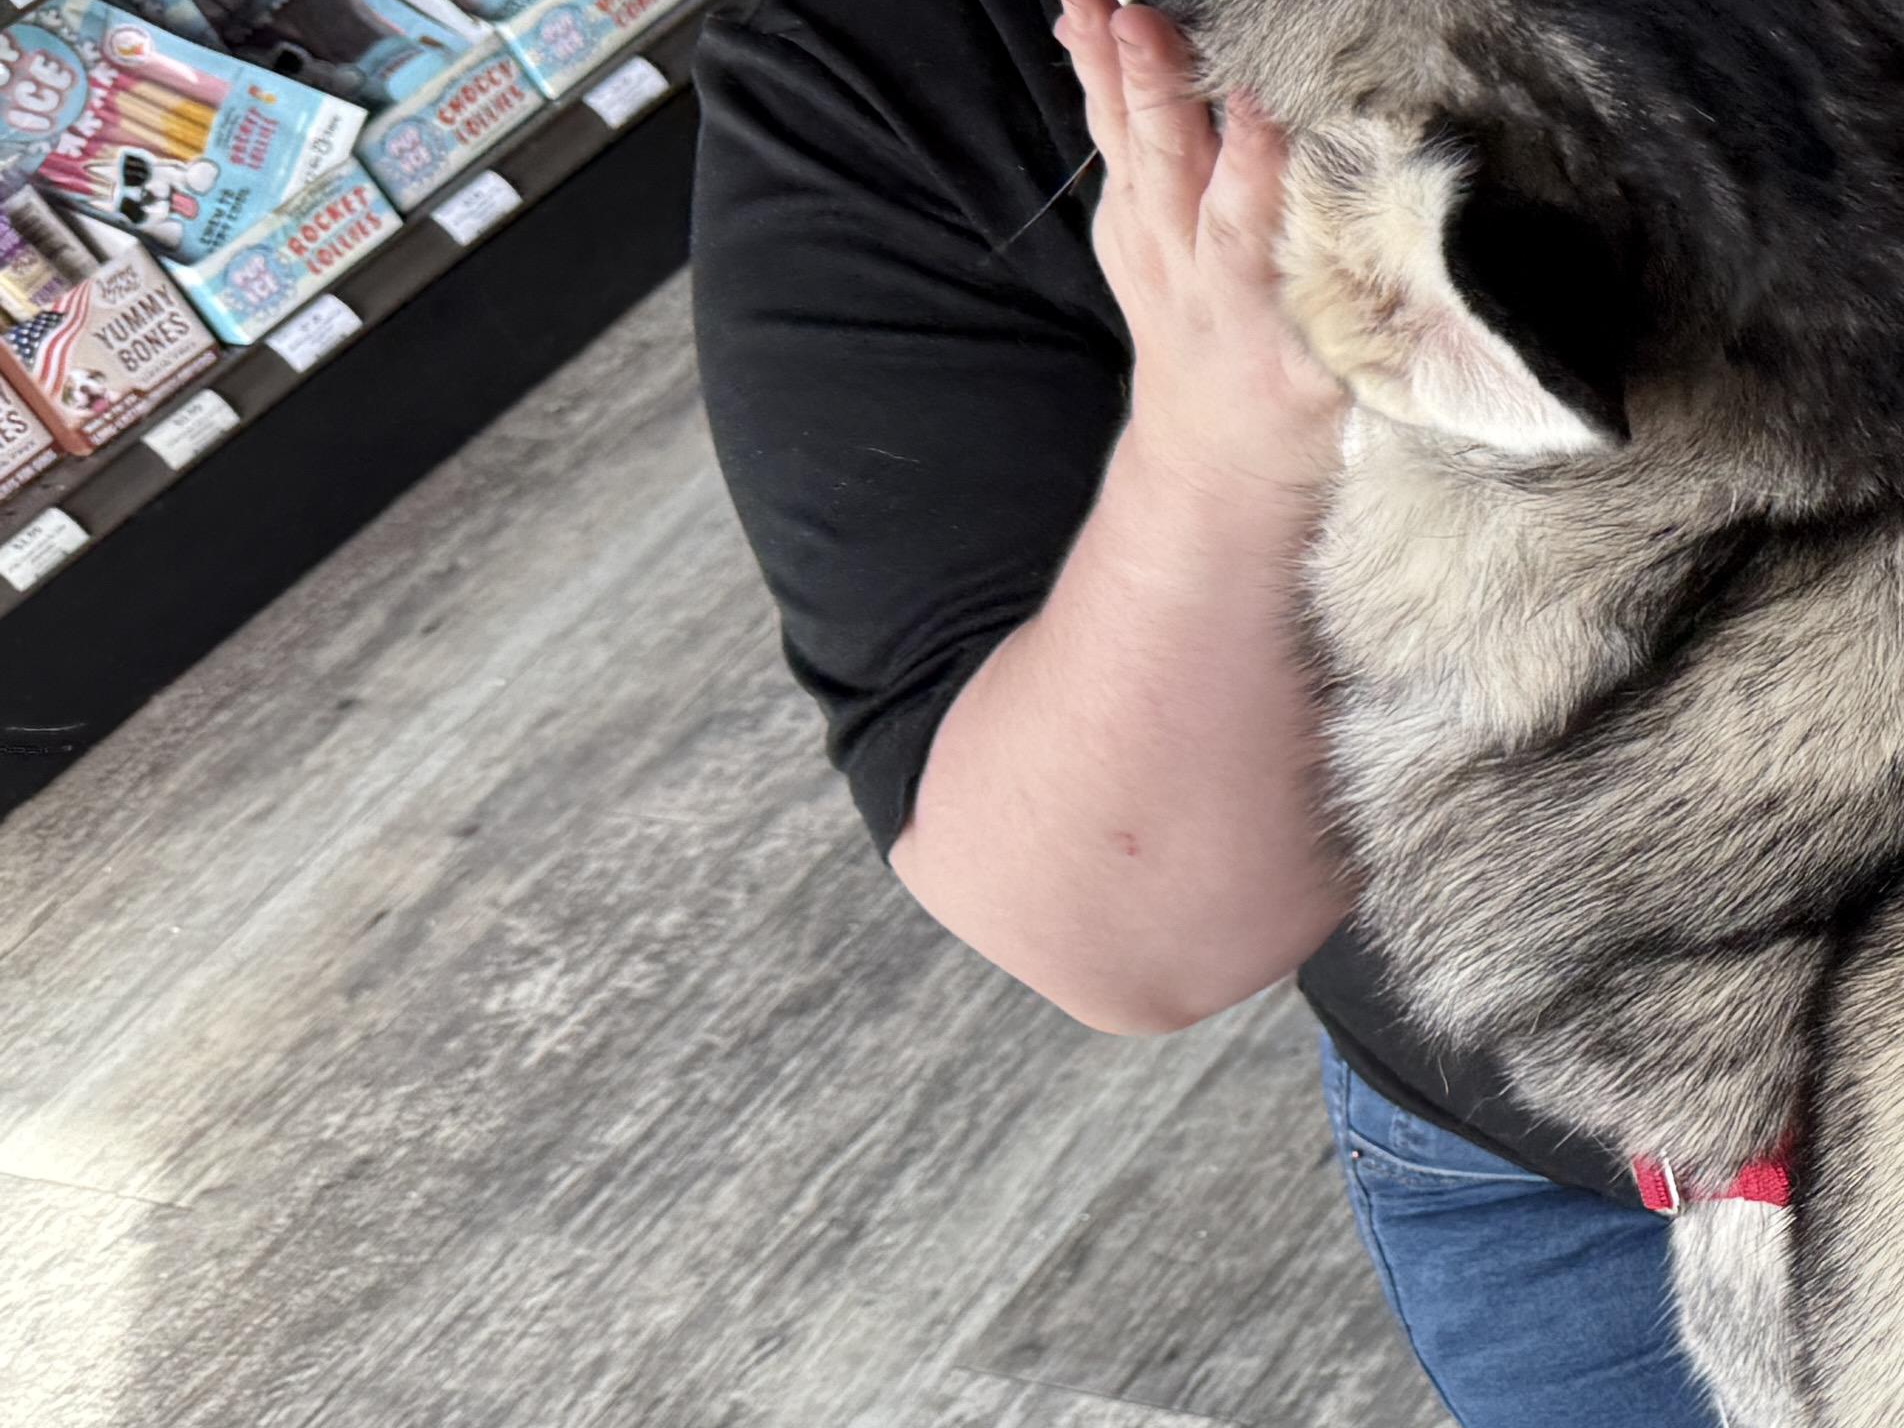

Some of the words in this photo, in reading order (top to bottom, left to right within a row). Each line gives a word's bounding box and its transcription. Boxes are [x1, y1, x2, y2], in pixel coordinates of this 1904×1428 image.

[6, 52, 74, 132] ICE
[287, 185, 370, 258] ROCKET
[306, 211, 383, 277] LOLLIES
[94, 283, 175, 351] YUMMY
[117, 311, 190, 373] BONES
